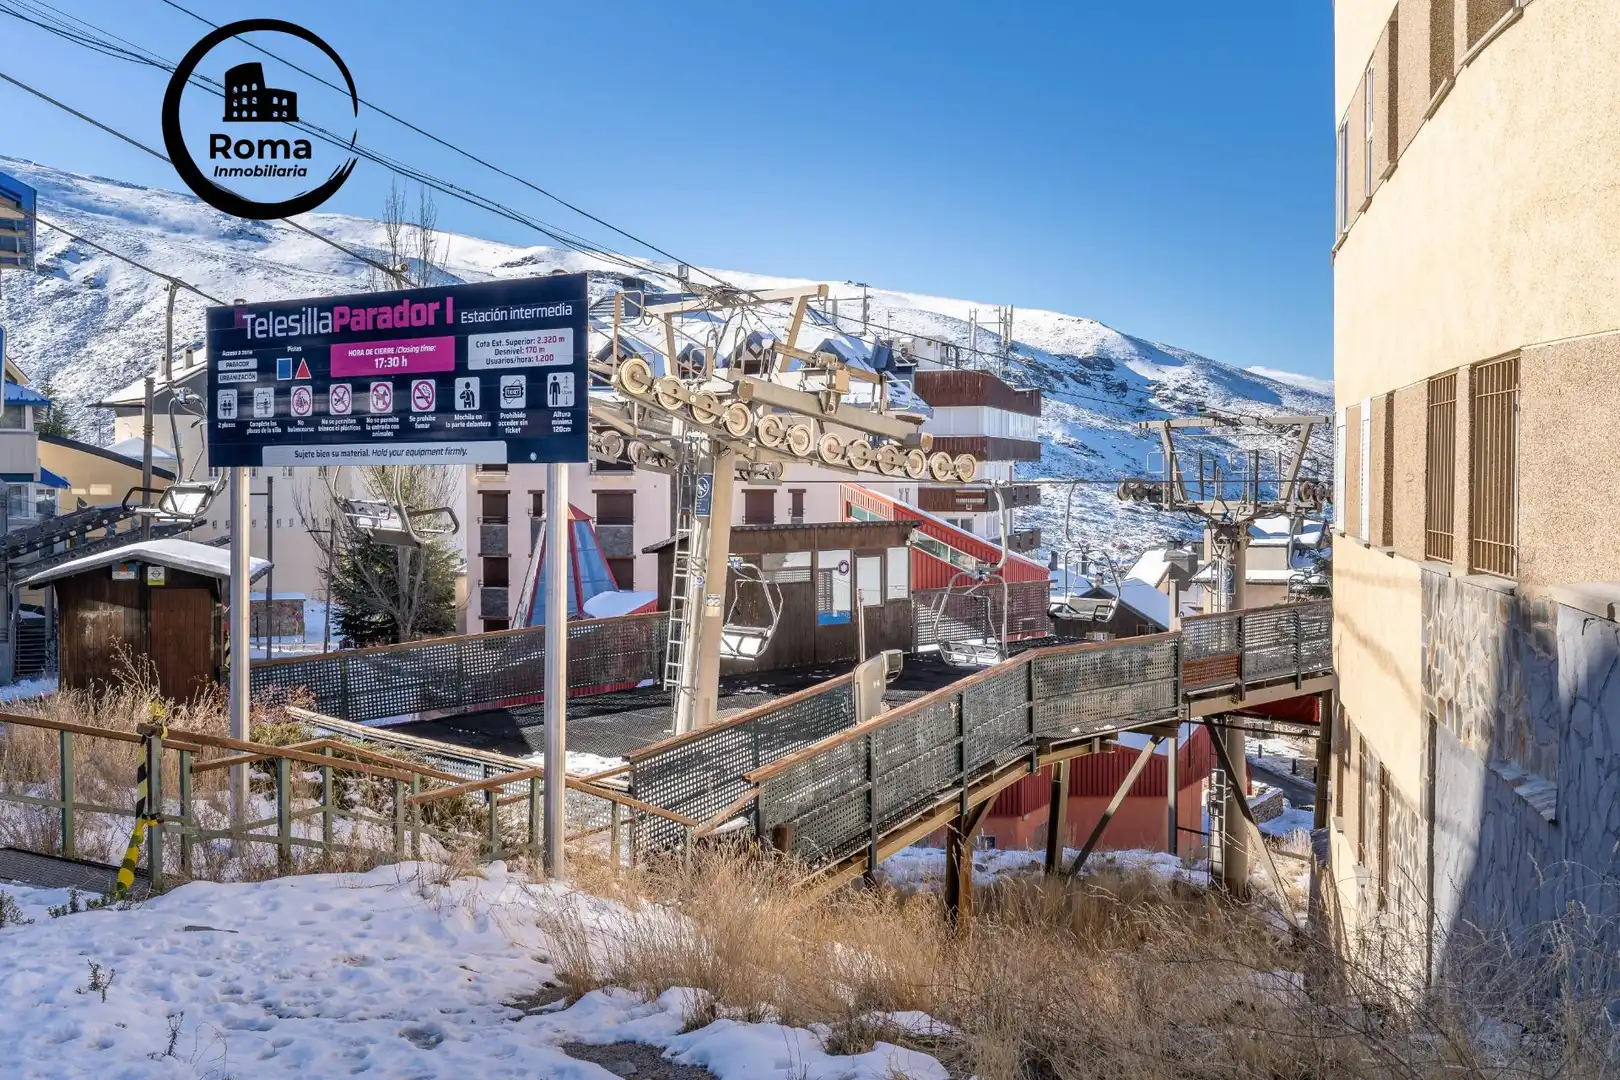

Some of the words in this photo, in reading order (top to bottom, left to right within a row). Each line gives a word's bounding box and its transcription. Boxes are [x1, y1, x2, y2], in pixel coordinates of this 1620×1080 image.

[461, 308, 507, 324] Estación
[510, 302, 572, 320] intermedia
[475, 340, 490, 348] Cota
[491, 339, 504, 347] Est.
[505, 337, 536, 347] Superior:
[537, 335, 557, 344] 2.320
[348, 348, 365, 357] HORA
[374, 347, 395, 355] CIERRE
[494, 348, 524, 356] Desnivel:
[525, 346, 537, 354] 170
[374, 357, 399, 369] 17:30
[401, 355, 408, 367] h
[535, 353, 555, 362] 1.200
[451, 421, 466, 429] parte
[294, 450, 314, 460] Sujete
[316, 449, 331, 458] bien
[331, 450, 340, 458] su
[341, 448, 370, 457] material.
[372, 448, 388, 457] Hold
[388, 448, 405, 458] your
[405, 447, 444, 458] equipment
[444, 446, 468, 457] firmly.
